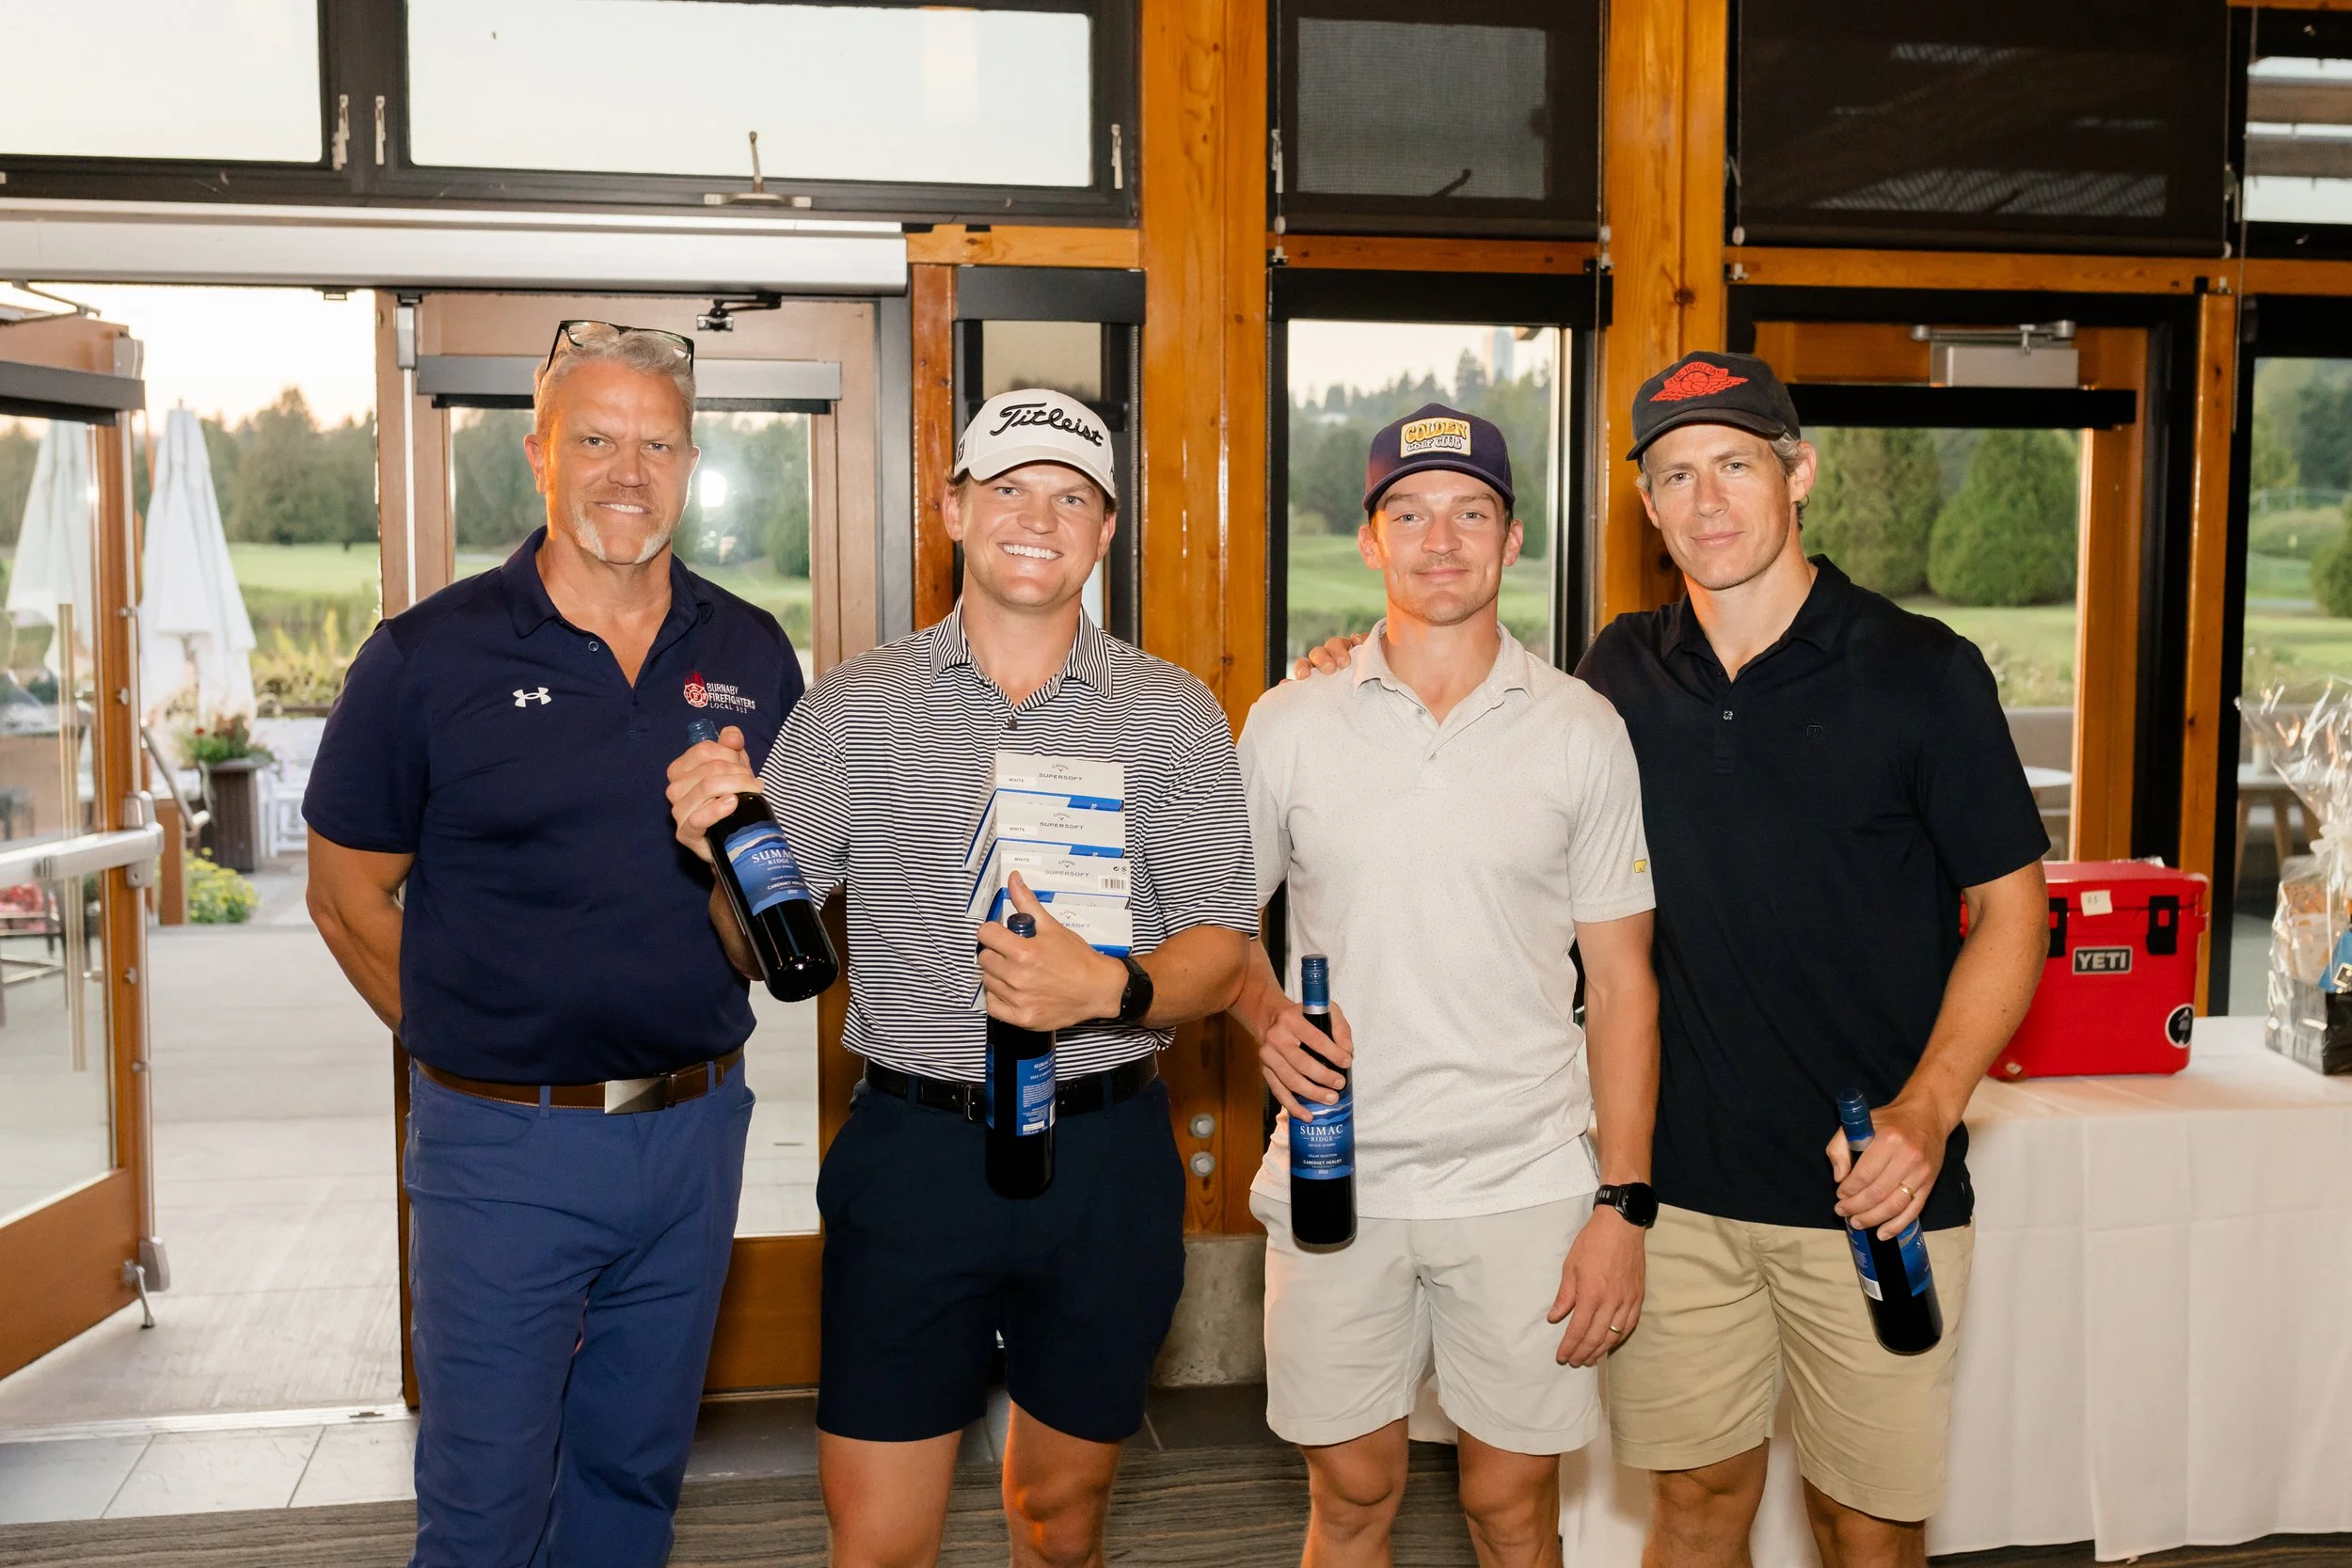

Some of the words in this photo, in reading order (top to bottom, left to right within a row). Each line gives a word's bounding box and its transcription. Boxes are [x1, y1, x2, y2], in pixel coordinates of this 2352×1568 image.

[990, 403, 1104, 447] Titleist
[1405, 421, 1468, 444] GOLDEN
[1435, 436, 1462, 449] CLUB
[707, 682, 739, 695] BURNABY
[707, 692, 756, 710] FIREFIGHTERS
[709, 703, 734, 711] LOCAL
[1039, 772, 1084, 782] SUPERSOFT
[1039, 821, 1085, 830] SUPERSOFT
[1044, 869, 1091, 878] SUPERSOFT
[2077, 952, 2127, 970] YETI
[1299, 1124, 1343, 1136] SUMAC
